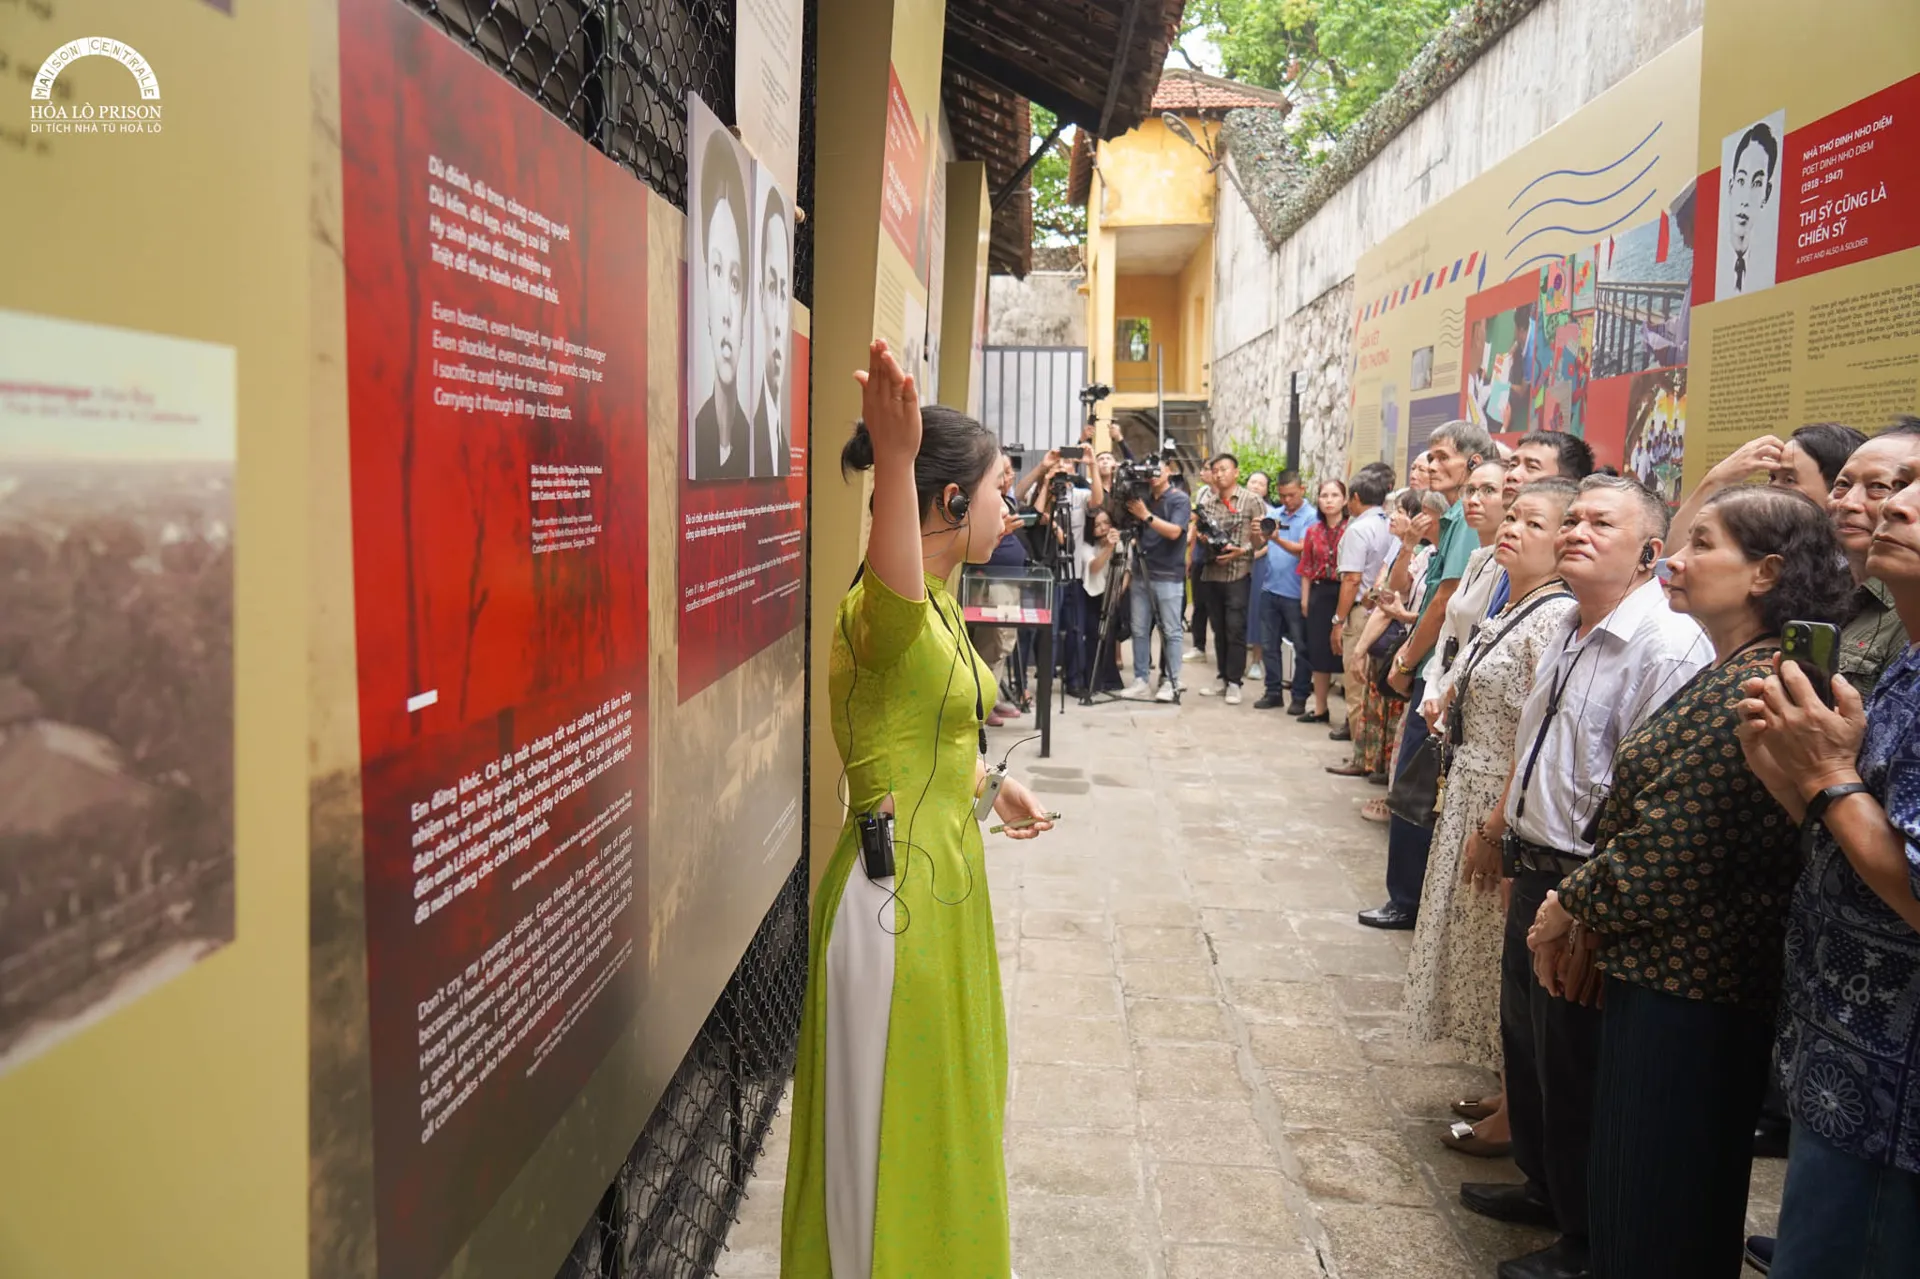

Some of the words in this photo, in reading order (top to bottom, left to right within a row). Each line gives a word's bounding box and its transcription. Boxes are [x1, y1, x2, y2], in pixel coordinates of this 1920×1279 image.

[1803, 147, 1818, 161] NHÀ
[1820, 139, 1834, 154] THƠ
[1835, 133, 1853, 148] ĐINH
[1855, 125, 1871, 140] NHO
[1802, 163, 1818, 176] POET
[1838, 149, 1854, 162] NHO
[1801, 179, 1819, 194] (1918
[1825, 169, 1843, 184] 1947)
[1800, 209, 1816, 226] THI
[1819, 201, 1833, 221] SỸ
[1835, 191, 1867, 214] CŨNG
[1871, 181, 1887, 203] LÀ
[1798, 222, 1829, 248] CHIẾN
[1832, 216, 1847, 236] SỸ
[1800, 253, 1813, 263] POET
[1814, 249, 1825, 259] AND
[1826, 244, 1840, 256] ALSO
[1845, 237, 1868, 251] SOLDIER
[432, 301, 456, 322] Even
[540, 335, 551, 351] my
[432, 329, 456, 350] Even
[548, 360, 558, 375] my
[439, 363, 476, 382] sacrifice
[524, 403, 535, 418] my
